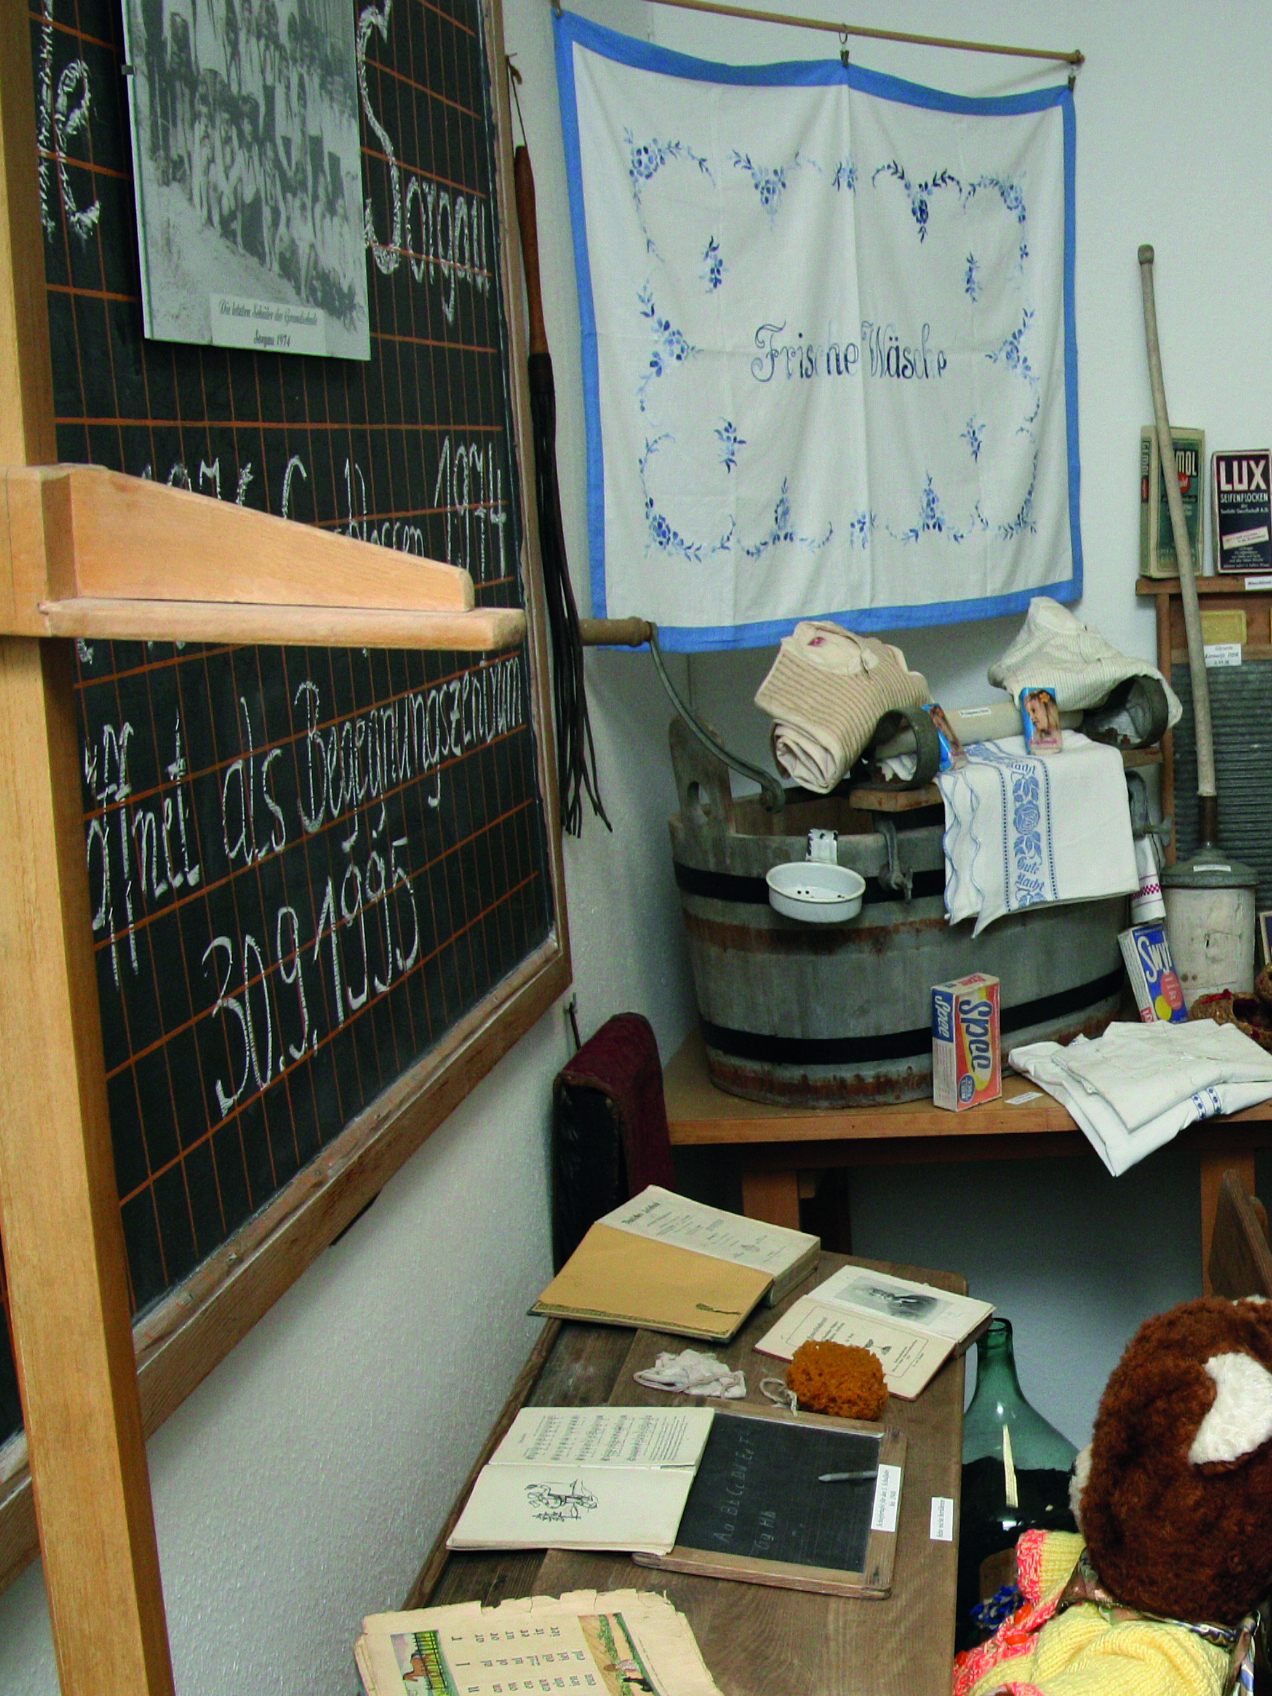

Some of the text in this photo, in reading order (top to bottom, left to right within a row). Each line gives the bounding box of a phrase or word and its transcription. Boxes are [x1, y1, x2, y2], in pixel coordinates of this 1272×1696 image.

[751, 320, 948, 383] Frische Wäsche
[1175, 450, 1198, 477] MOL
[1219, 460, 1267, 491] LUX
[1220, 491, 1268, 504] SEIFENFLOCKEN
[222, 696, 286, 868] als
[1017, 857, 1039, 876] Gute
[934, 995, 951, 1039] Spee
[958, 999, 993, 1073] Spee
